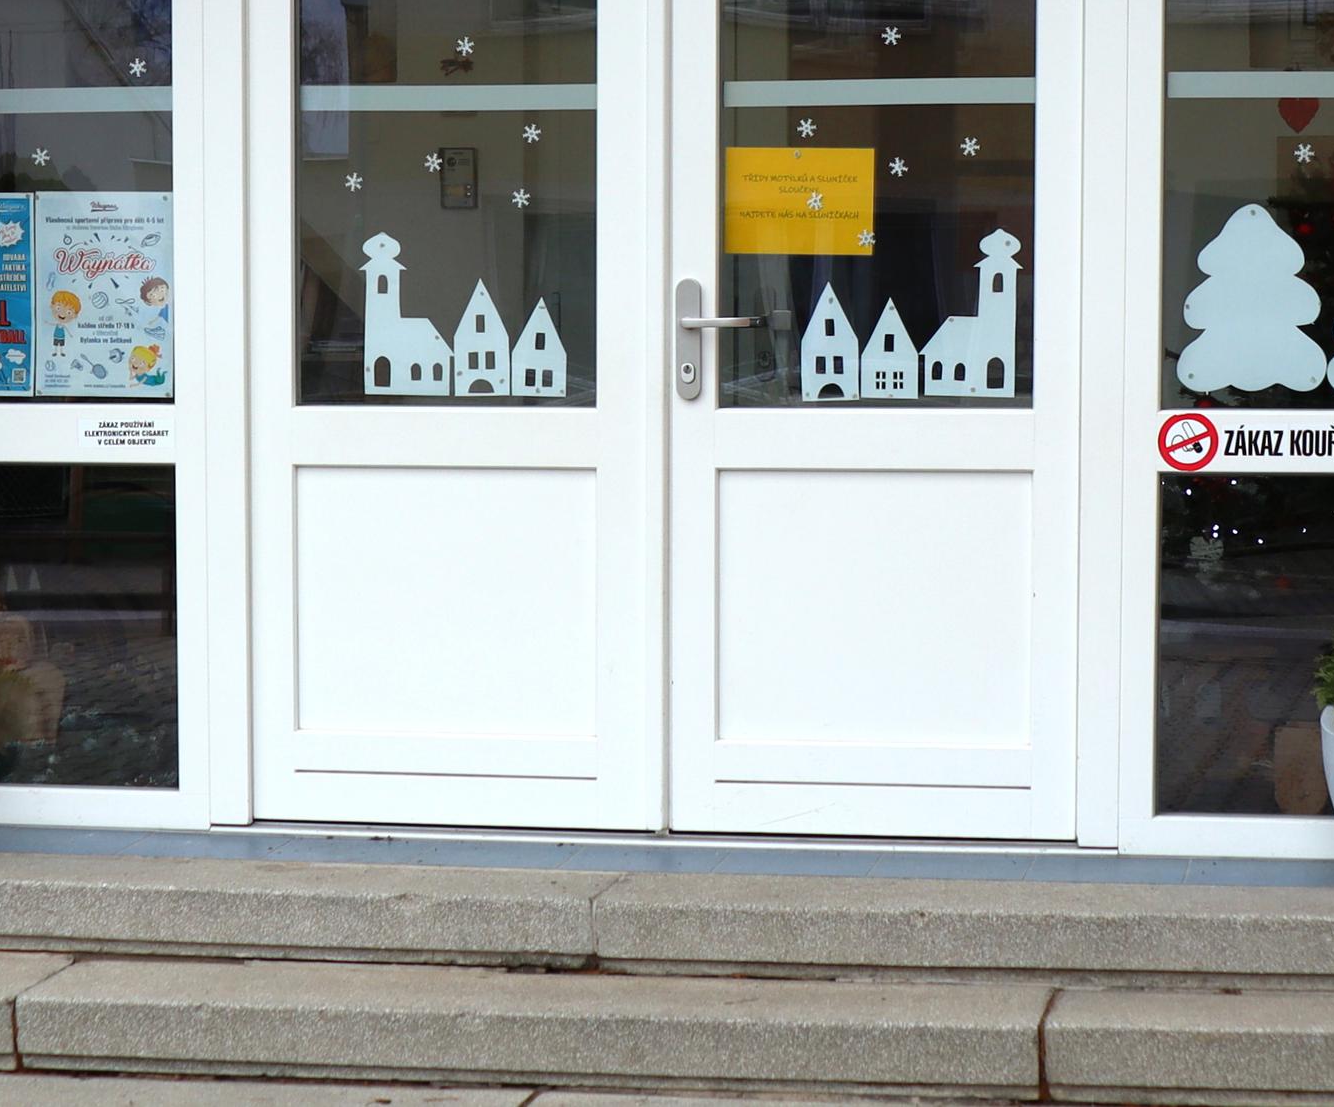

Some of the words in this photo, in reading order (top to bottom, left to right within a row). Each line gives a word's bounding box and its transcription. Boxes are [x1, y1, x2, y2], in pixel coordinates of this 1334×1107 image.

[98, 420, 119, 428] ZÁKAZ
[103, 438, 126, 446] CELÉM
[1223, 424, 1284, 456] ZÁKAZ
